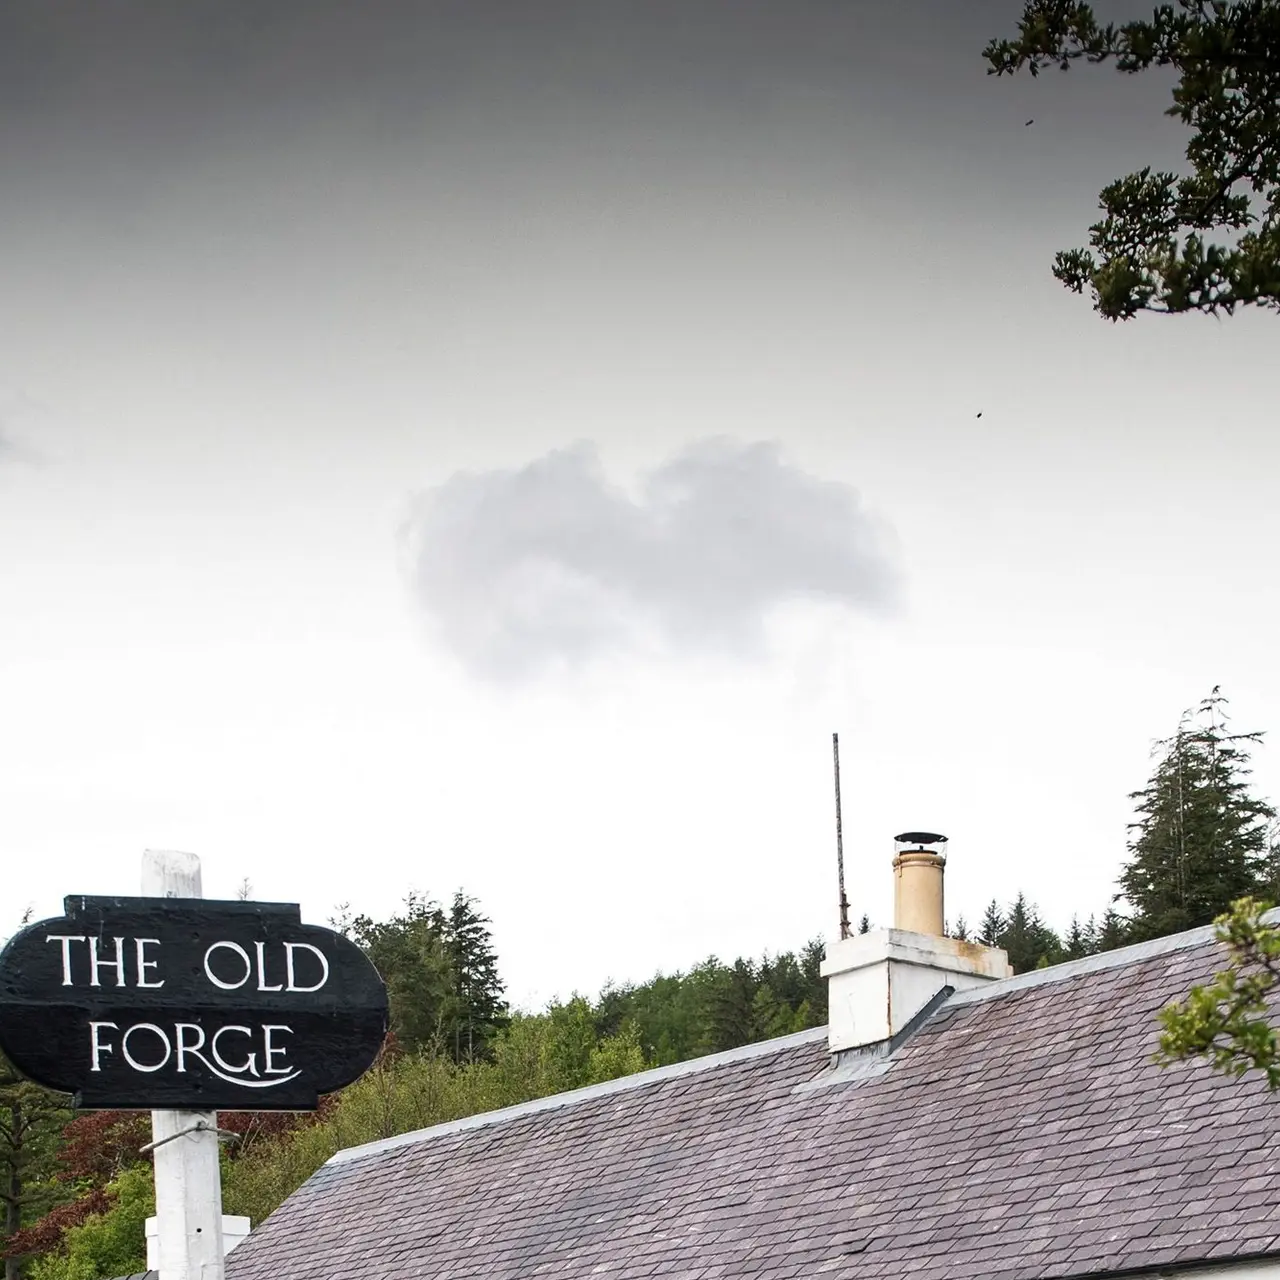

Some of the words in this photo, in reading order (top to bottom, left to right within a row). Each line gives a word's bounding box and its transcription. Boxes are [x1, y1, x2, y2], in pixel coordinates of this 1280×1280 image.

[46, 934, 165, 989] THE
[204, 940, 330, 993] OLD
[89, 1021, 303, 1088] FORGE
